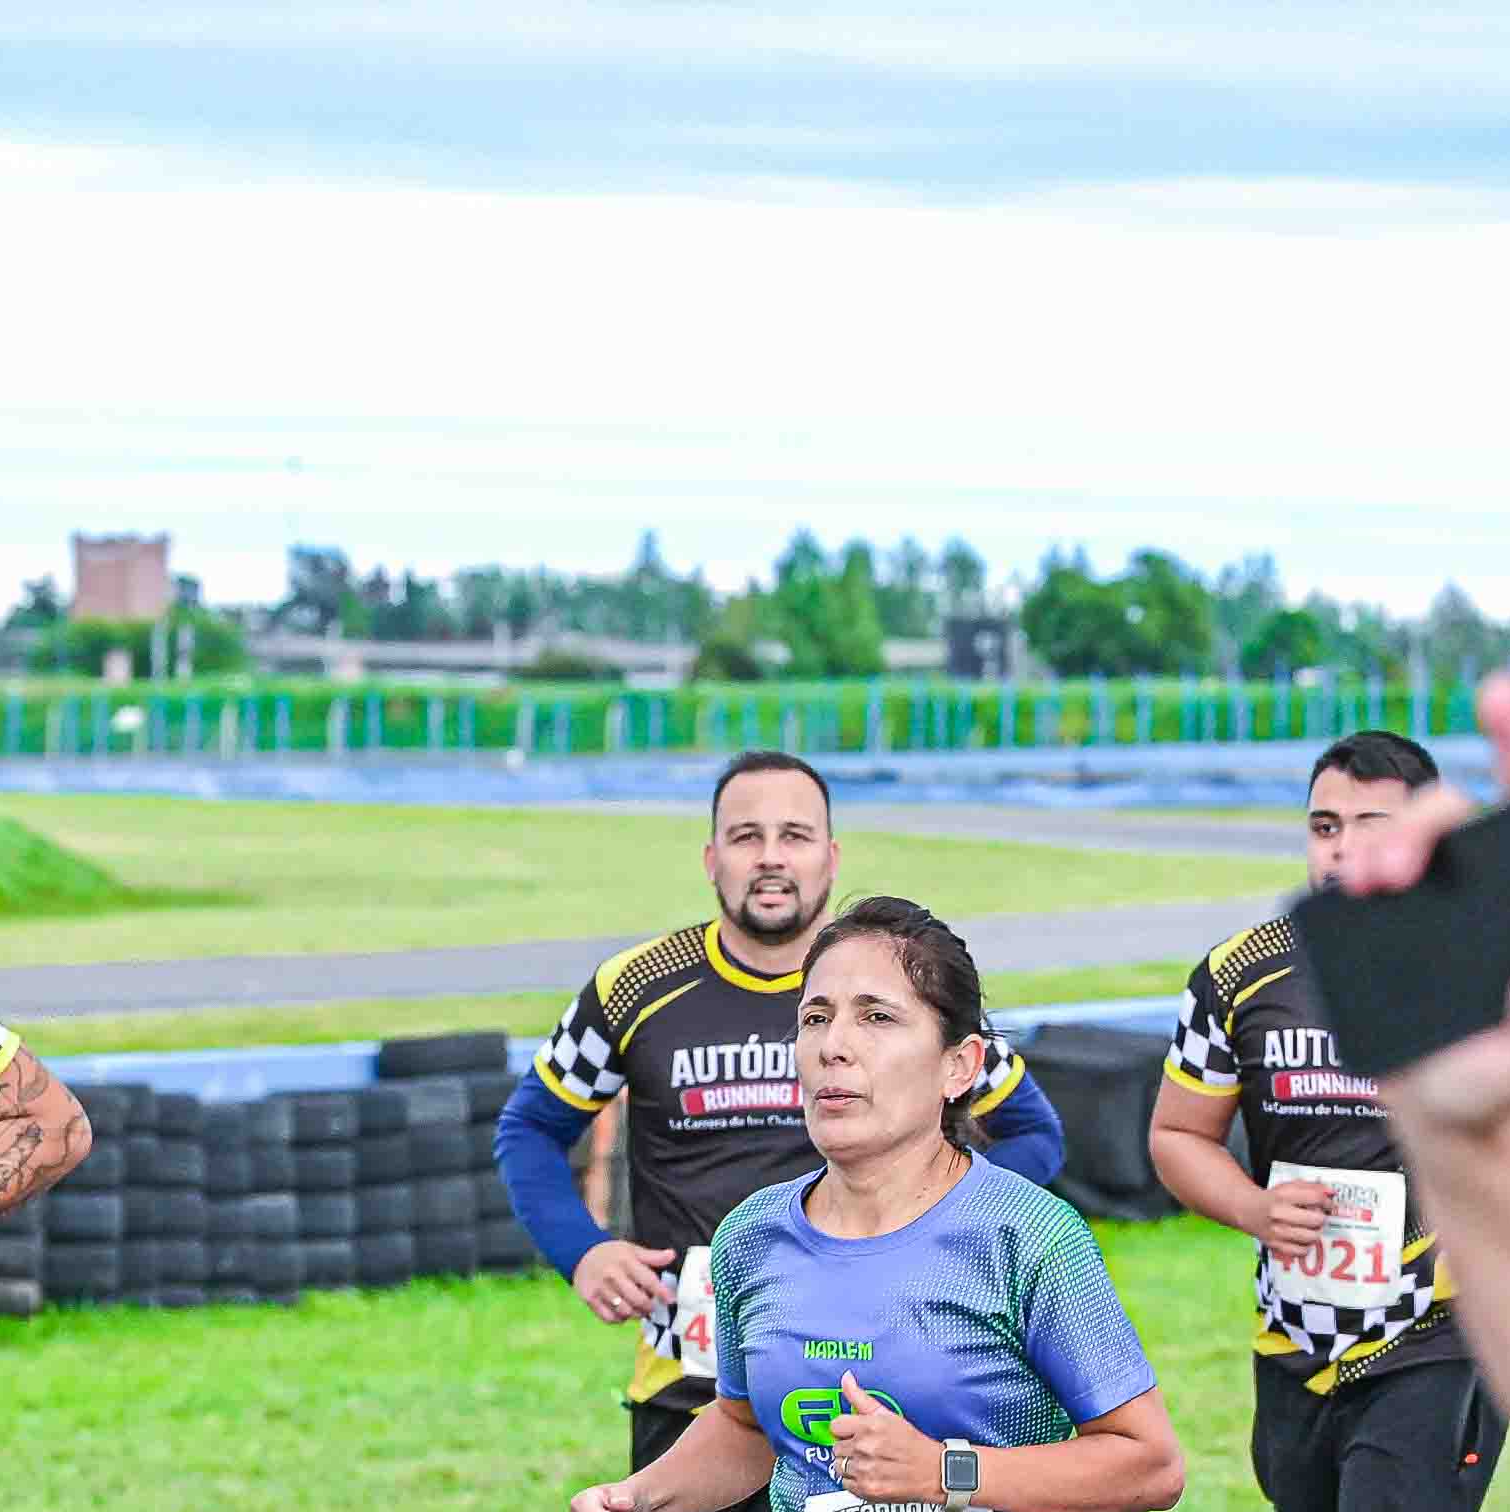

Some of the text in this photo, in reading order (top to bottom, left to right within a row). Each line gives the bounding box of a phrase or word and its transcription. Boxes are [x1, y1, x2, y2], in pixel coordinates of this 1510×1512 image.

[703, 1084, 792, 1113] RUNNING
[684, 1312, 712, 1353] 4
[803, 1340, 874, 1361] HARLEM
